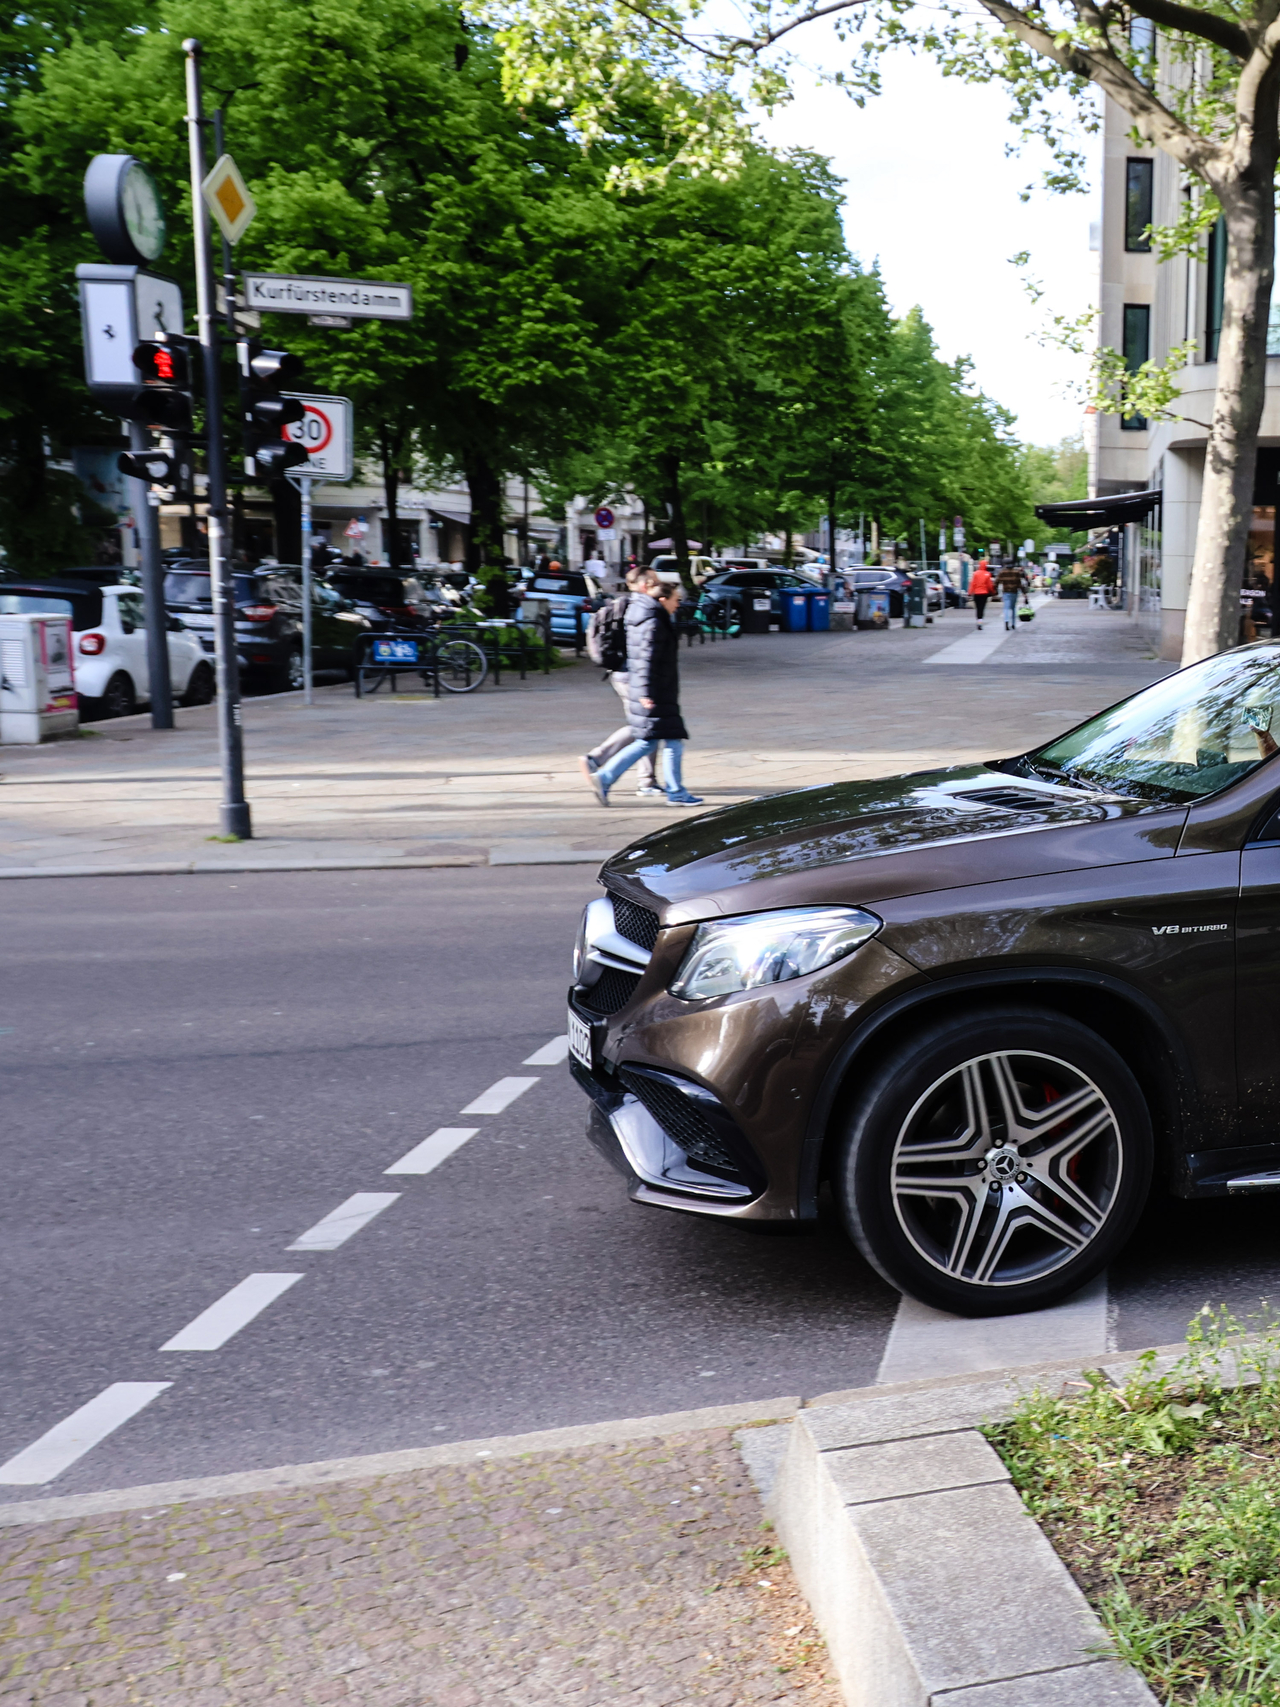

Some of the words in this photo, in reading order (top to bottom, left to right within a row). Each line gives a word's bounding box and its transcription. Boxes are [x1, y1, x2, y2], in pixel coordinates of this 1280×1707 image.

[252, 281, 401, 307] Kurfürstendamm
[292, 419, 321, 440] 30
[1151, 925, 1180, 936] V8
[1181, 923, 1228, 934] BITURBO
